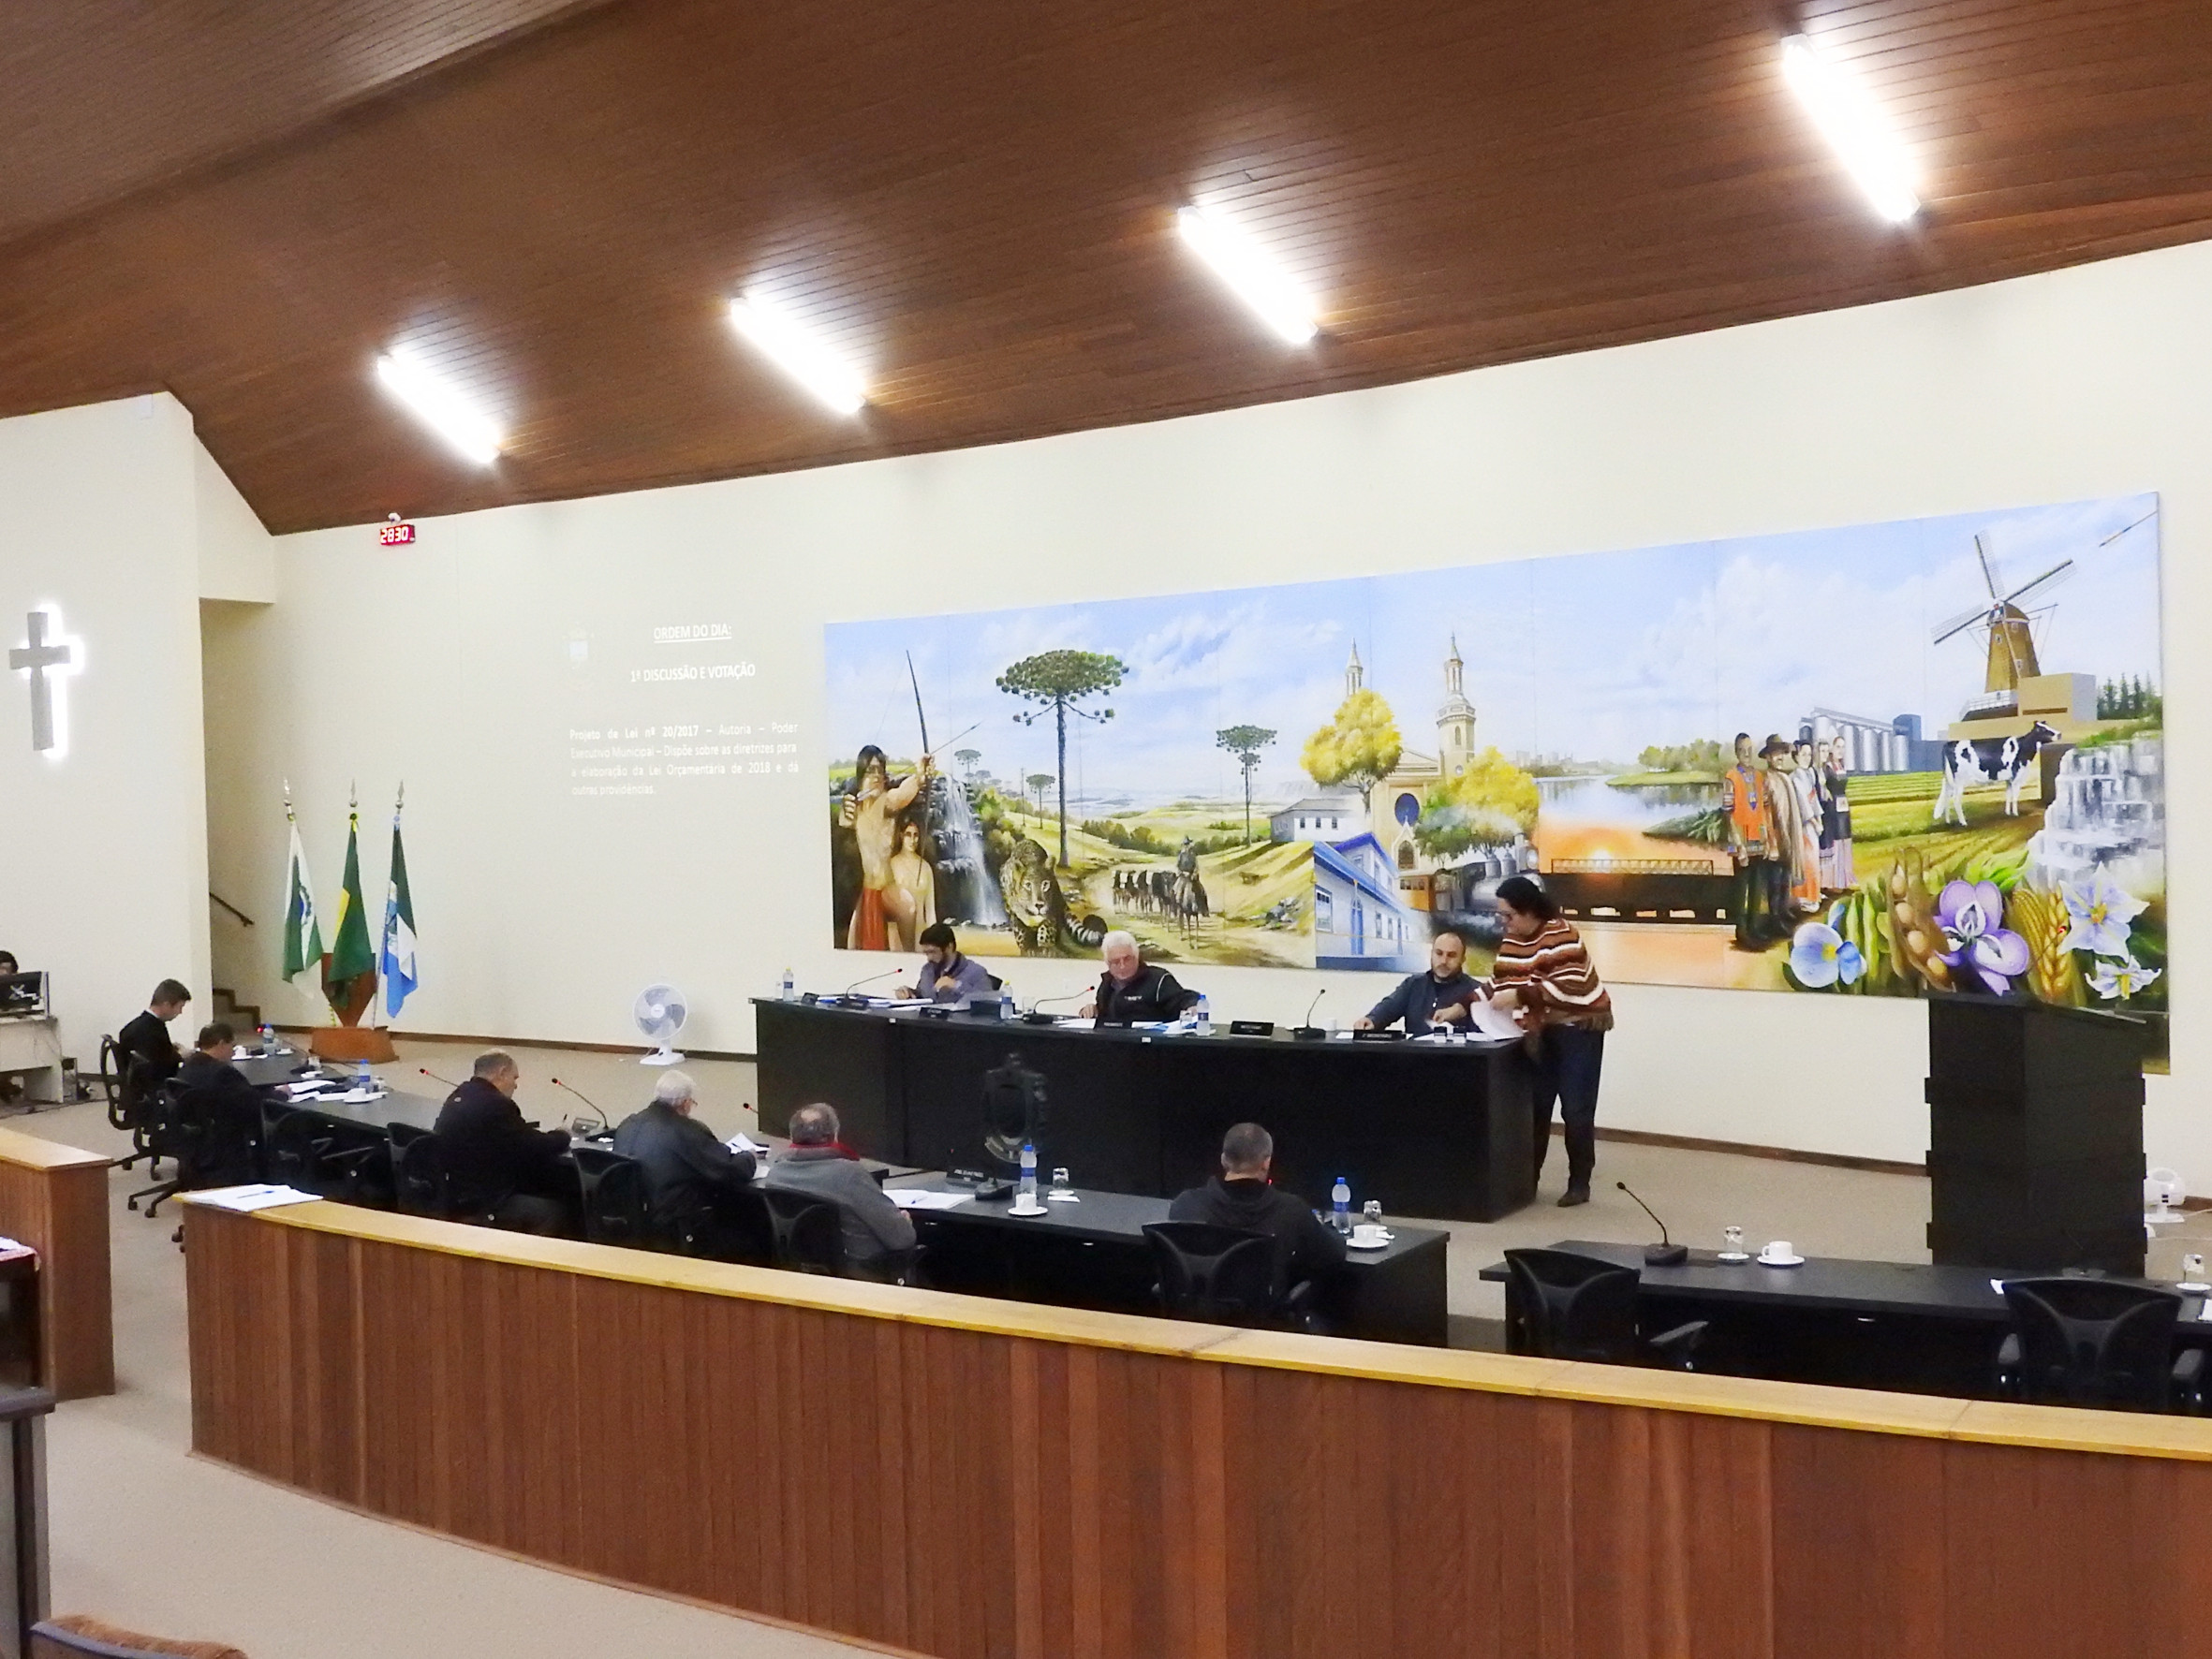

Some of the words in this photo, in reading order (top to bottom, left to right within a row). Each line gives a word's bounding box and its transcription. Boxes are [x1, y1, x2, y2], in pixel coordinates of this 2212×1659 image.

[654, 625, 690, 639] ORDEM
[693, 625, 708, 638] DO
[712, 624, 732, 637] DIA:
[643, 665, 698, 682] DISCUSSÃO
[700, 668, 706, 679] E
[708, 661, 756, 680] VOTAÇÃO
[569, 729, 601, 741] Projeto
[608, 728, 618, 739] de
[626, 727, 638, 739] Lei
[663, 725, 699, 740] 20/2017
[718, 724, 751, 735] Autoria
[772, 723, 798, 733] Poder
[570, 747, 611, 758] Executivo
[612, 746, 655, 758] Municipal
[664, 744, 693, 759] Dispõe
[695, 744, 719, 756] sobre
[721, 746, 731, 755] as
[733, 743, 774, 756] diretrizes
[777, 744, 797, 756] para
[571, 769, 576, 777] a
[582, 766, 627, 778] elaboração
[632, 765, 643, 776] da
[649, 765, 661, 775] Lei
[667, 763, 726, 778] Orçamentária
[731, 763, 742, 773] de
[748, 762, 771, 773] 2018
[788, 761, 799, 772] dá
[572, 785, 597, 796] outras
[600, 783, 656, 798] providências.
